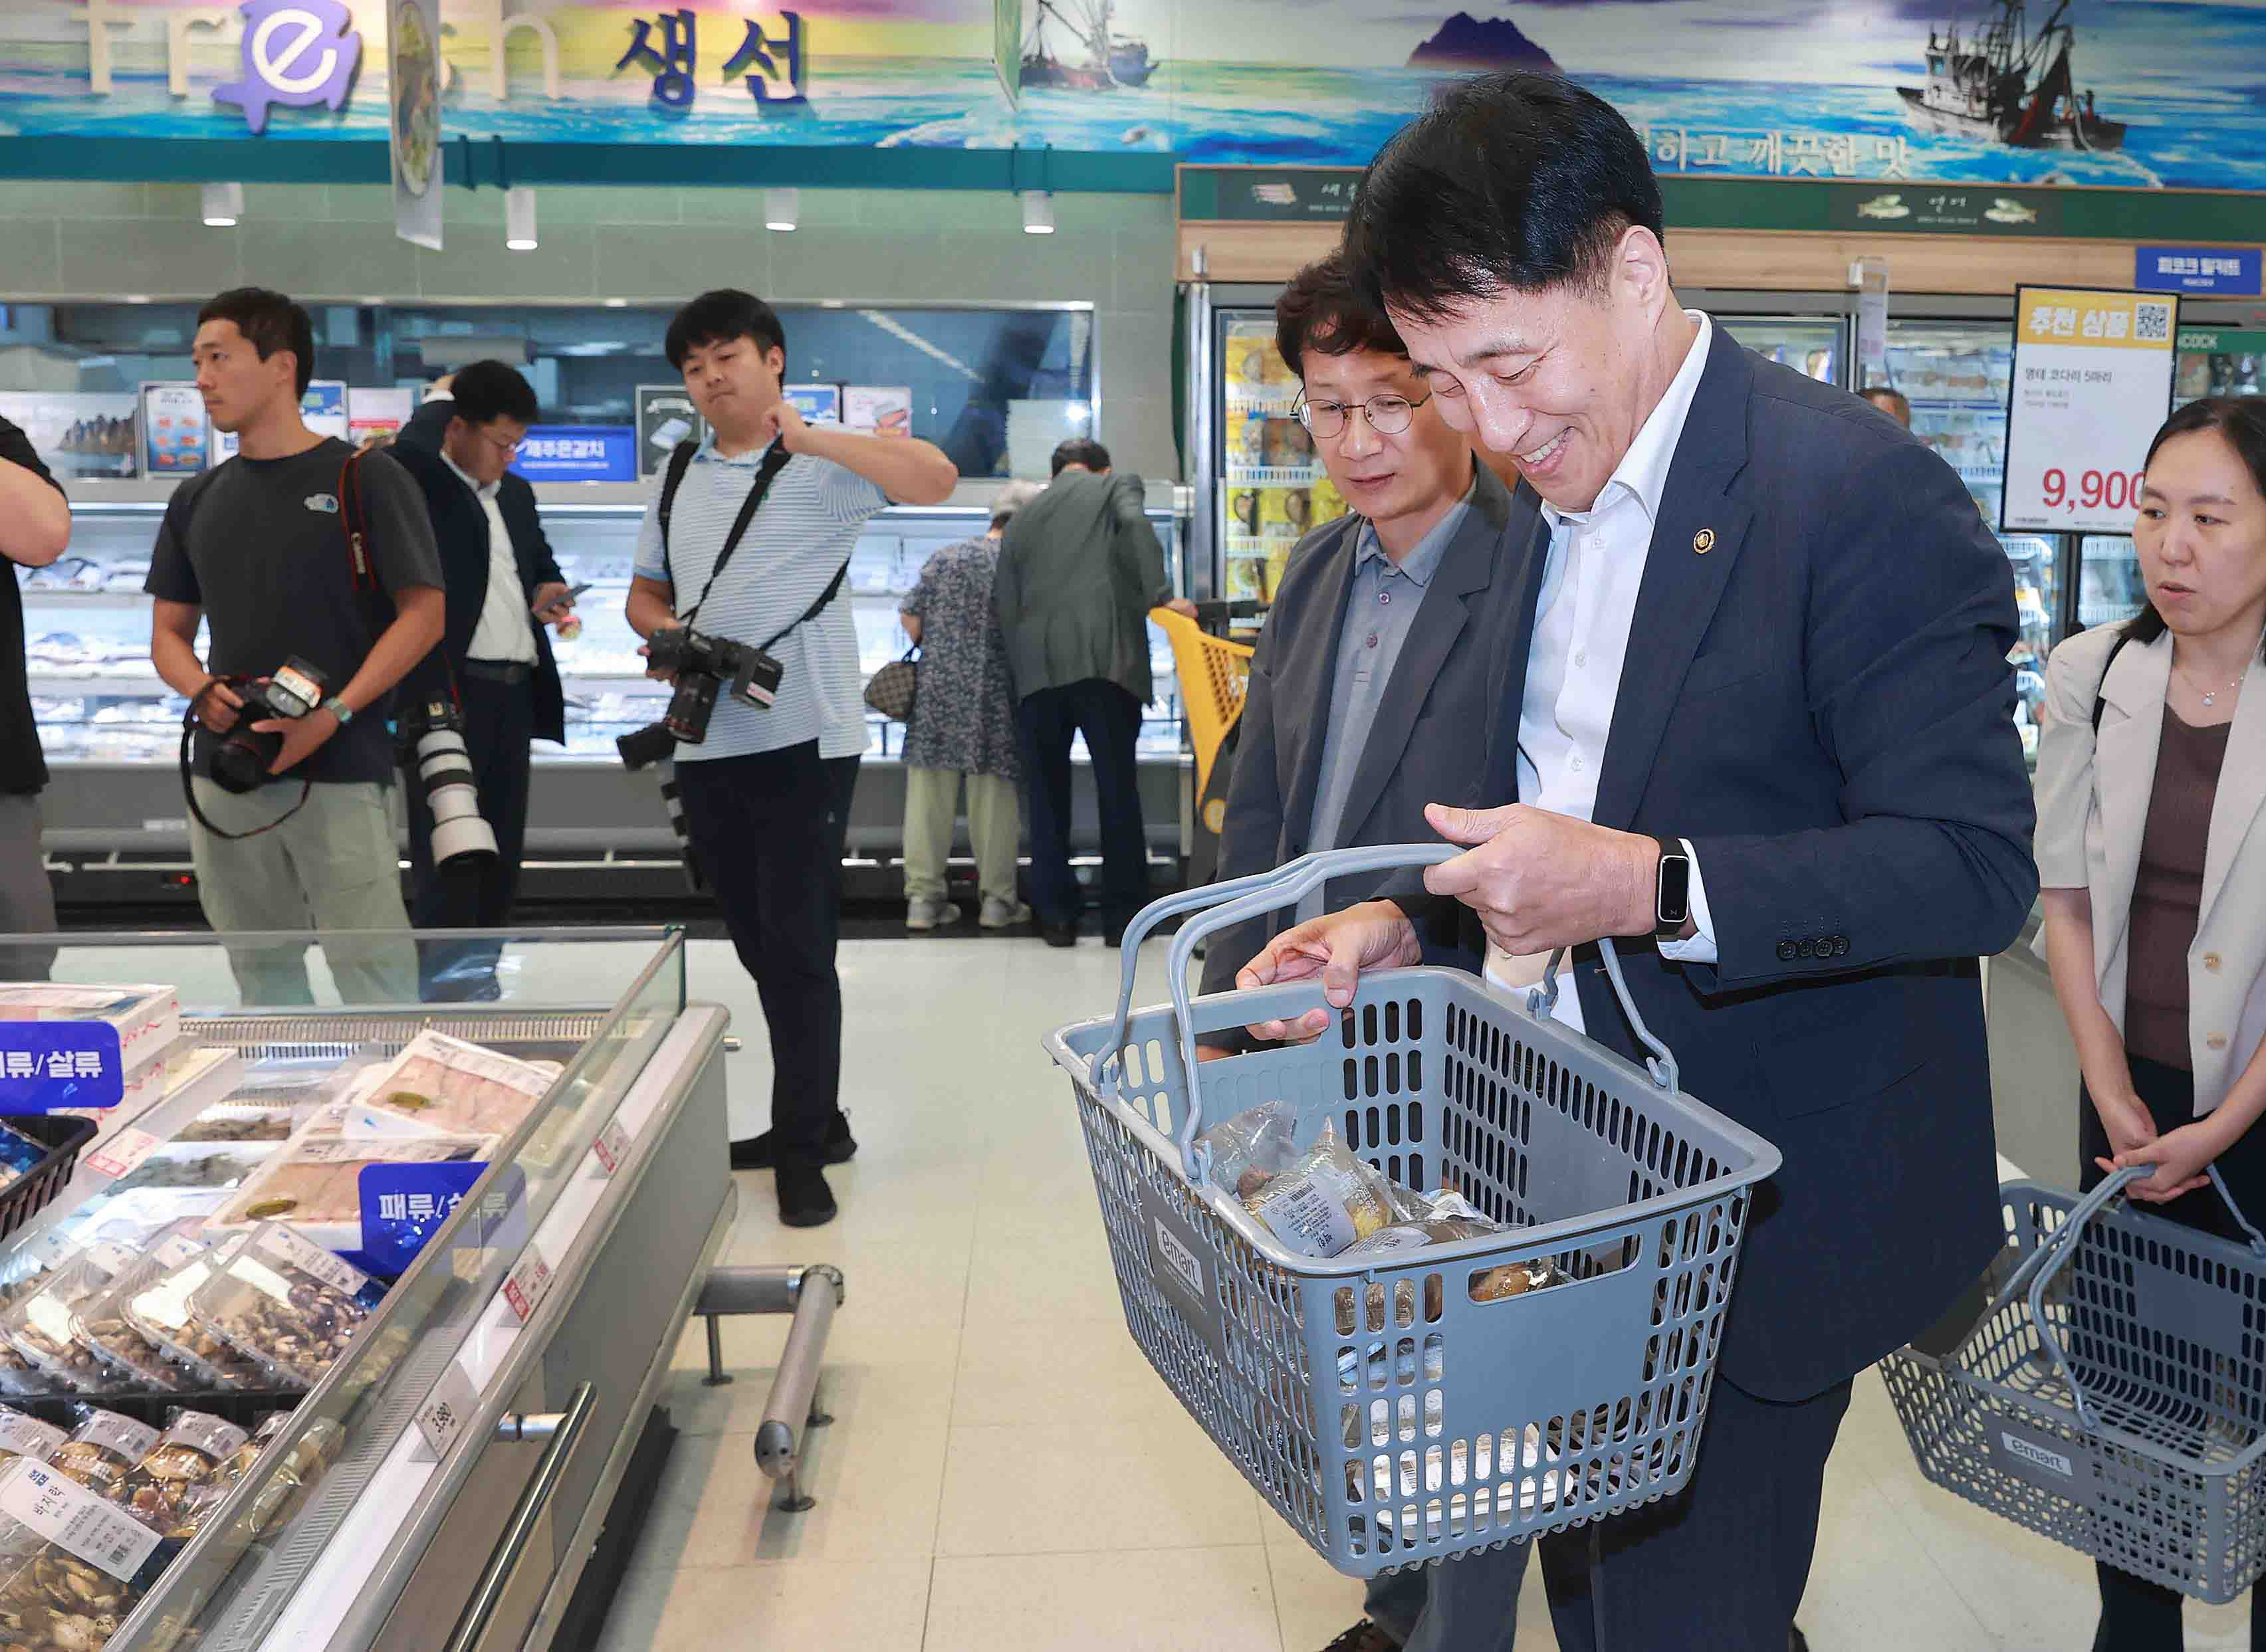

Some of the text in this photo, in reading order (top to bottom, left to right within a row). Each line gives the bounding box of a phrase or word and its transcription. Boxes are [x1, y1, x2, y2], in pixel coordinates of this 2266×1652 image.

[615, 9, 808, 104] 생선
[1644, 127, 1912, 181] 하고 깨끗한 맛
[2030, 307, 2131, 338] 추천 상품
[2043, 468, 2146, 514] 9,900
[1162, 1230, 1198, 1286] emart
[2011, 1439, 2063, 1471] emart
